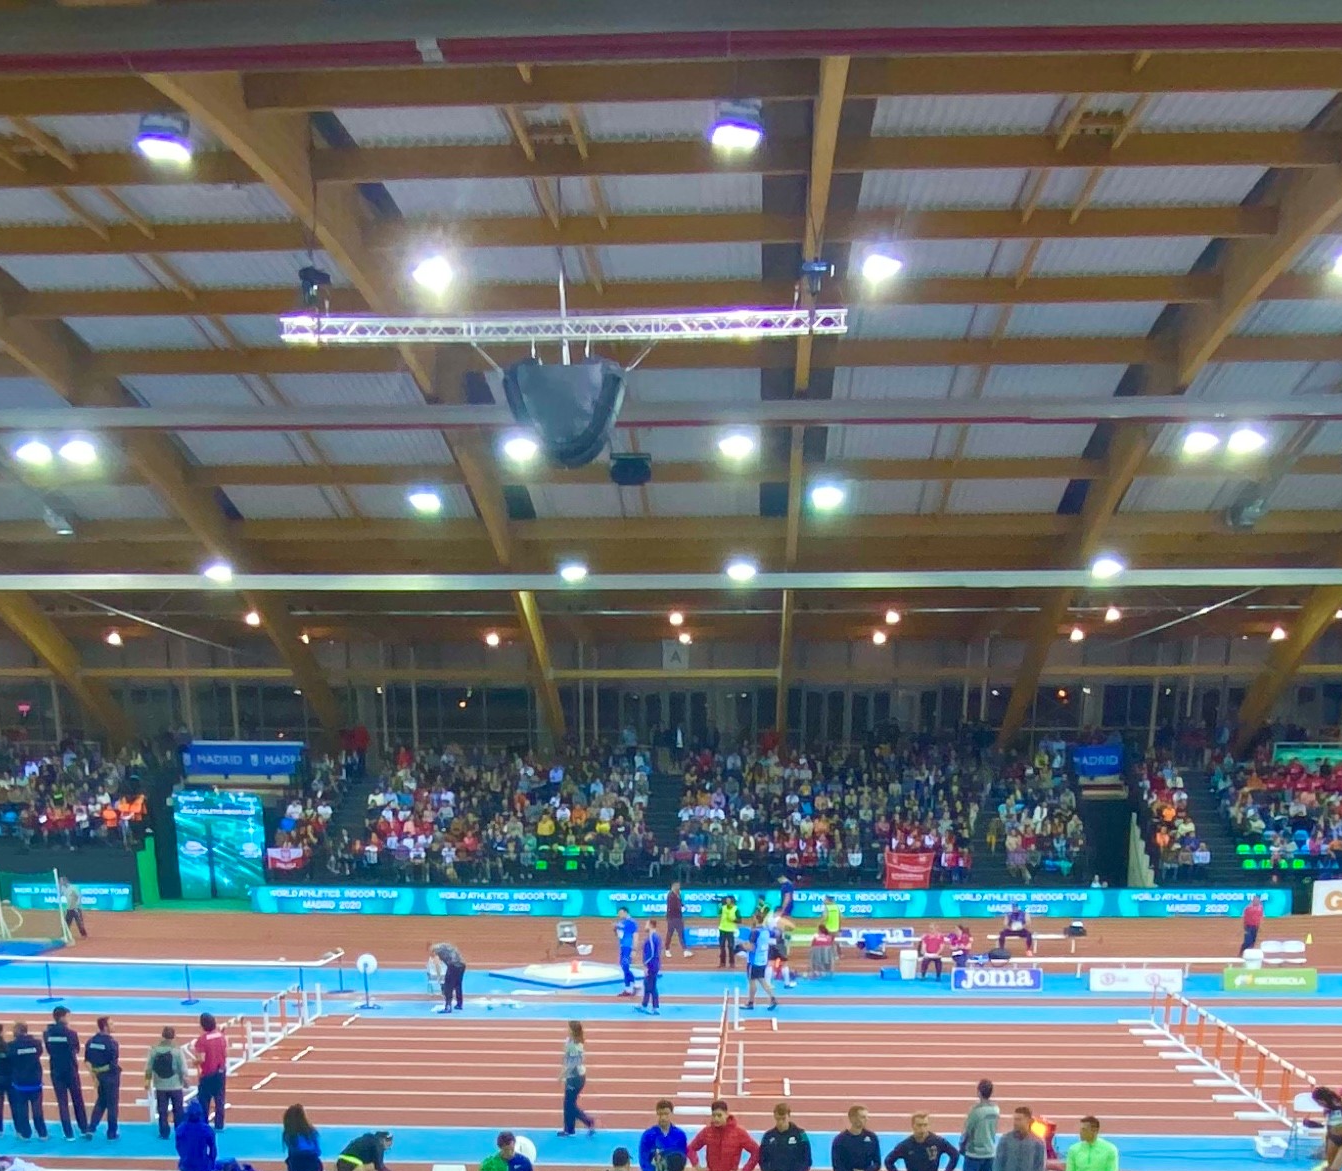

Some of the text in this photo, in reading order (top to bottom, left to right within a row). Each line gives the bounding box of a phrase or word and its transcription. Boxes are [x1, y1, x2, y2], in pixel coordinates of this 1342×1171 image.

[197, 754, 242, 765] MADRID
[270, 889, 398, 898] WORLD ATHLETICS INDOOR TOUR
[439, 891, 568, 900] WORLD ATHLETICS INDOOR TOUR
[609, 893, 637, 901] WORLD
[855, 893, 887, 901] INDOOR
[889, 893, 910, 901] TOUR
[953, 893, 1087, 902] WORLD ATHLETICS INDOOR TOUR
[1131, 893, 1161, 901] WORLD
[1162, 893, 1207, 901] ATHLETICS
[1211, 893, 1244, 901] INDOOR
[302, 901, 361, 909] MADRID 2020
[472, 903, 531, 911] MADRID 2020
[1025, 904, 1048, 912] 2020
[1166, 904, 1229, 912] MADRID 2020
